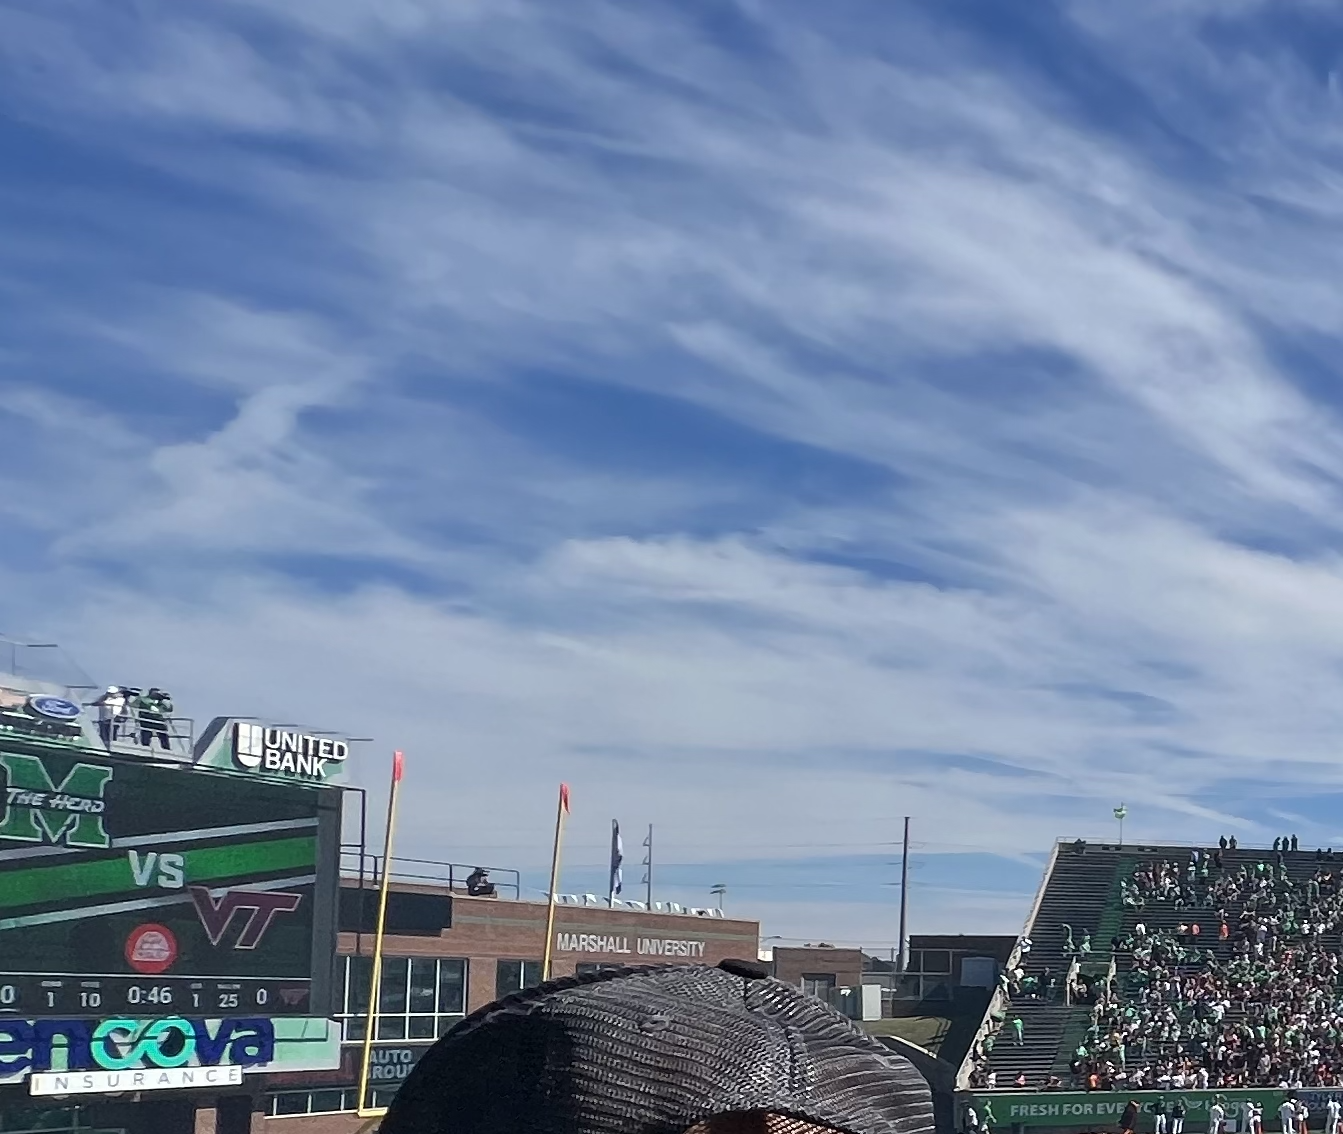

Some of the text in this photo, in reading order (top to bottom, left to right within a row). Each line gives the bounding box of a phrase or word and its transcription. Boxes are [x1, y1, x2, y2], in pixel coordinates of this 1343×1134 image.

[265, 728, 349, 761] UNITED
[265, 750, 327, 779] BANK
[50, 794, 106, 814] HERD
[128, 849, 185, 889] VS
[190, 885, 303, 951] VT
[557, 932, 706, 958] MARSHALL UNIVERSITY
[80, 992, 102, 1008] 10
[127, 986, 173, 1005] 0:46
[218, 993, 239, 1008] 25
[256, 988, 268, 1006] 0
[370, 1049, 413, 1063] AUTO
[33, 1069, 240, 1092] INSURANCE
[1010, 1104, 1058, 1117] FRESH
[1062, 1103, 1094, 1115] FOR
